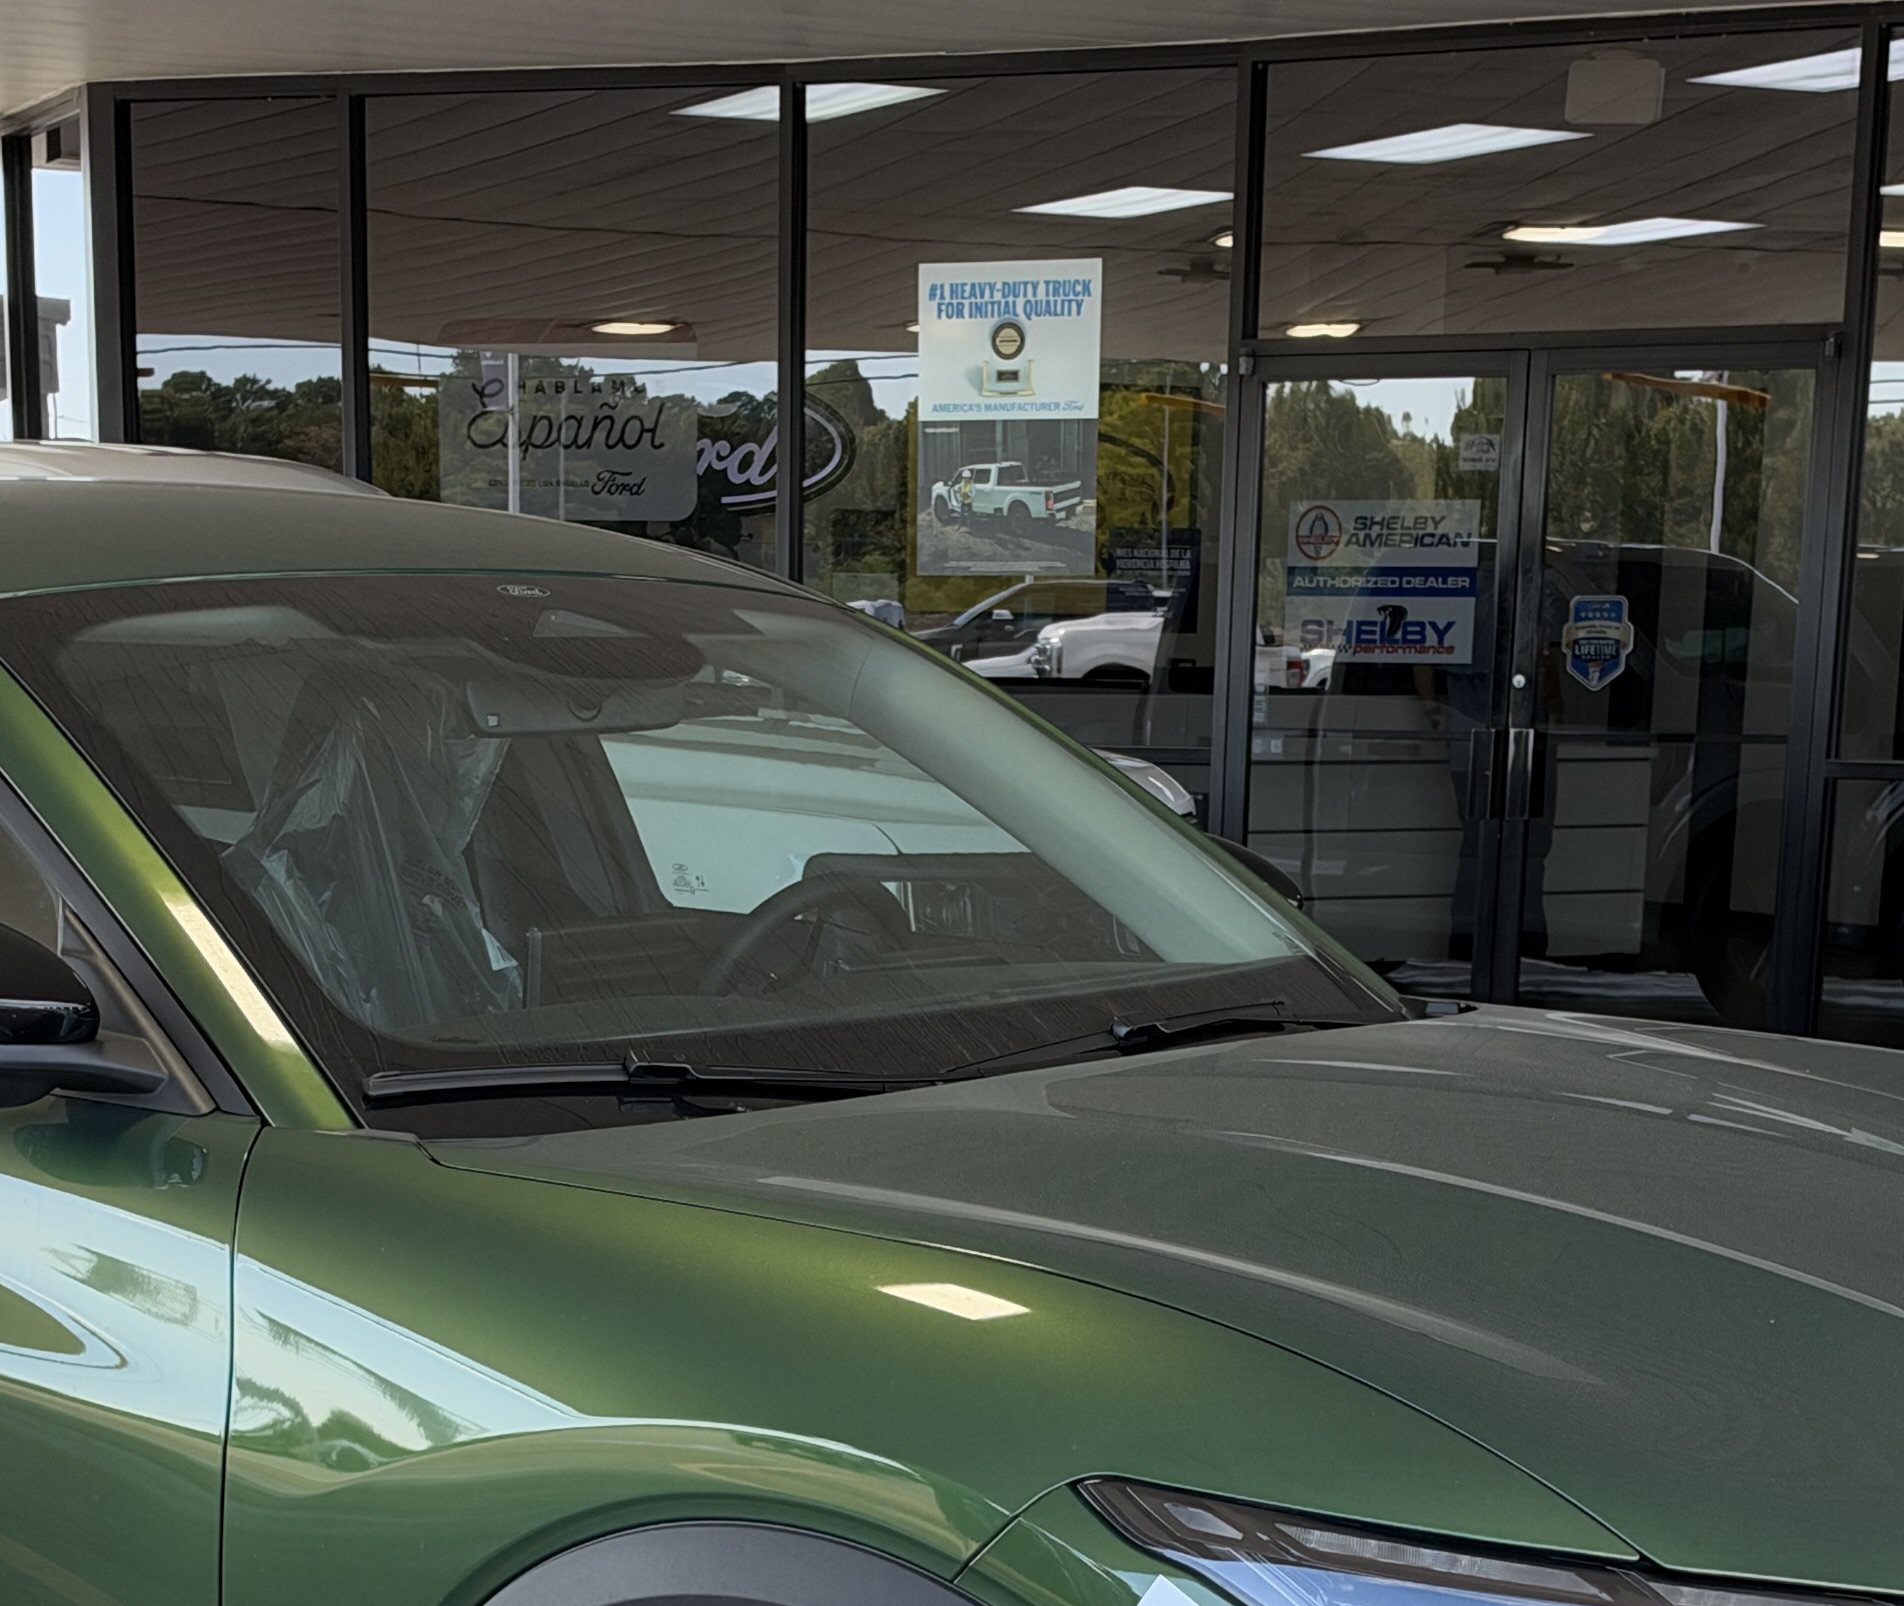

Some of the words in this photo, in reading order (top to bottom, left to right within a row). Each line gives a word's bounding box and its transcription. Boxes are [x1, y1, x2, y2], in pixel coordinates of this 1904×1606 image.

[928, 283, 946, 301] #1
[949, 280, 1040, 300] HEAVY-DUTY
[1043, 279, 1092, 298] TRUCK
[937, 302, 965, 320] FOR
[969, 300, 1020, 318] INITIAL
[1023, 299, 1085, 320] QUALITY
[517, 380, 663, 394] HABLAMO
[932, 402, 983, 413] AMERICA'S
[984, 401, 1061, 413] MANUFACTURER
[592, 469, 647, 496] Ford
[1353, 515, 1447, 532] SHELBY
[1345, 532, 1472, 548] AMERICAN
[1293, 576, 1400, 588] AUTHORIZED
[1402, 576, 1471, 588] DEALER
[1300, 619, 1456, 646] SHELBY
[1352, 644, 1456, 656] performance
